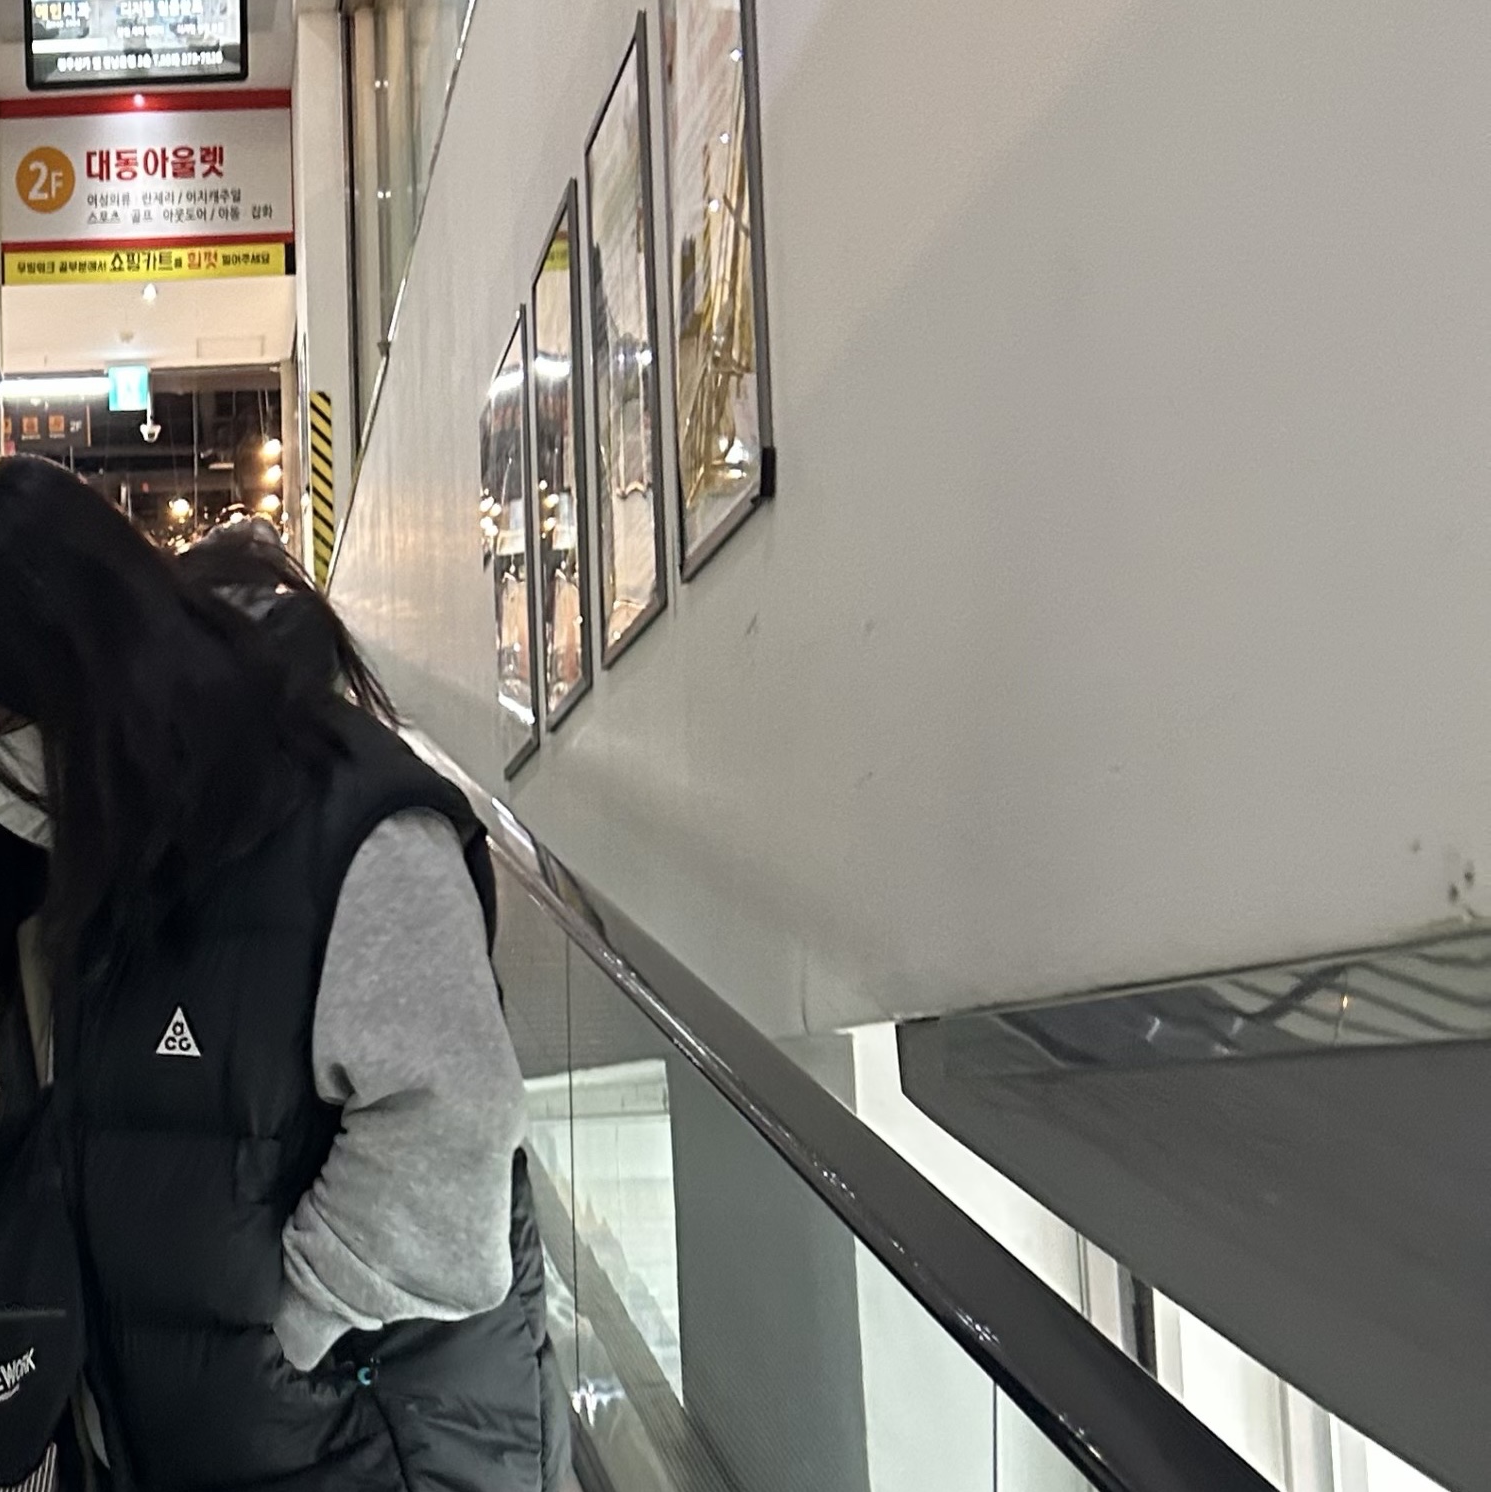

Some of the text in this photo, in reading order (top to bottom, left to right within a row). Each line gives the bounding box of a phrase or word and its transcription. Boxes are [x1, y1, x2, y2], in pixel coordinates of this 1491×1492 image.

[85, 145, 225, 181] 대동아울렛
[27, 161, 64, 200] 2F
[87, 210, 121, 224] 스포츠
[131, 208, 154, 223] 골프
[162, 206, 207, 223] 아웃도어
[109, 250, 183, 272] 쇼핑카트를
[187, 249, 219, 270] 힘껏
